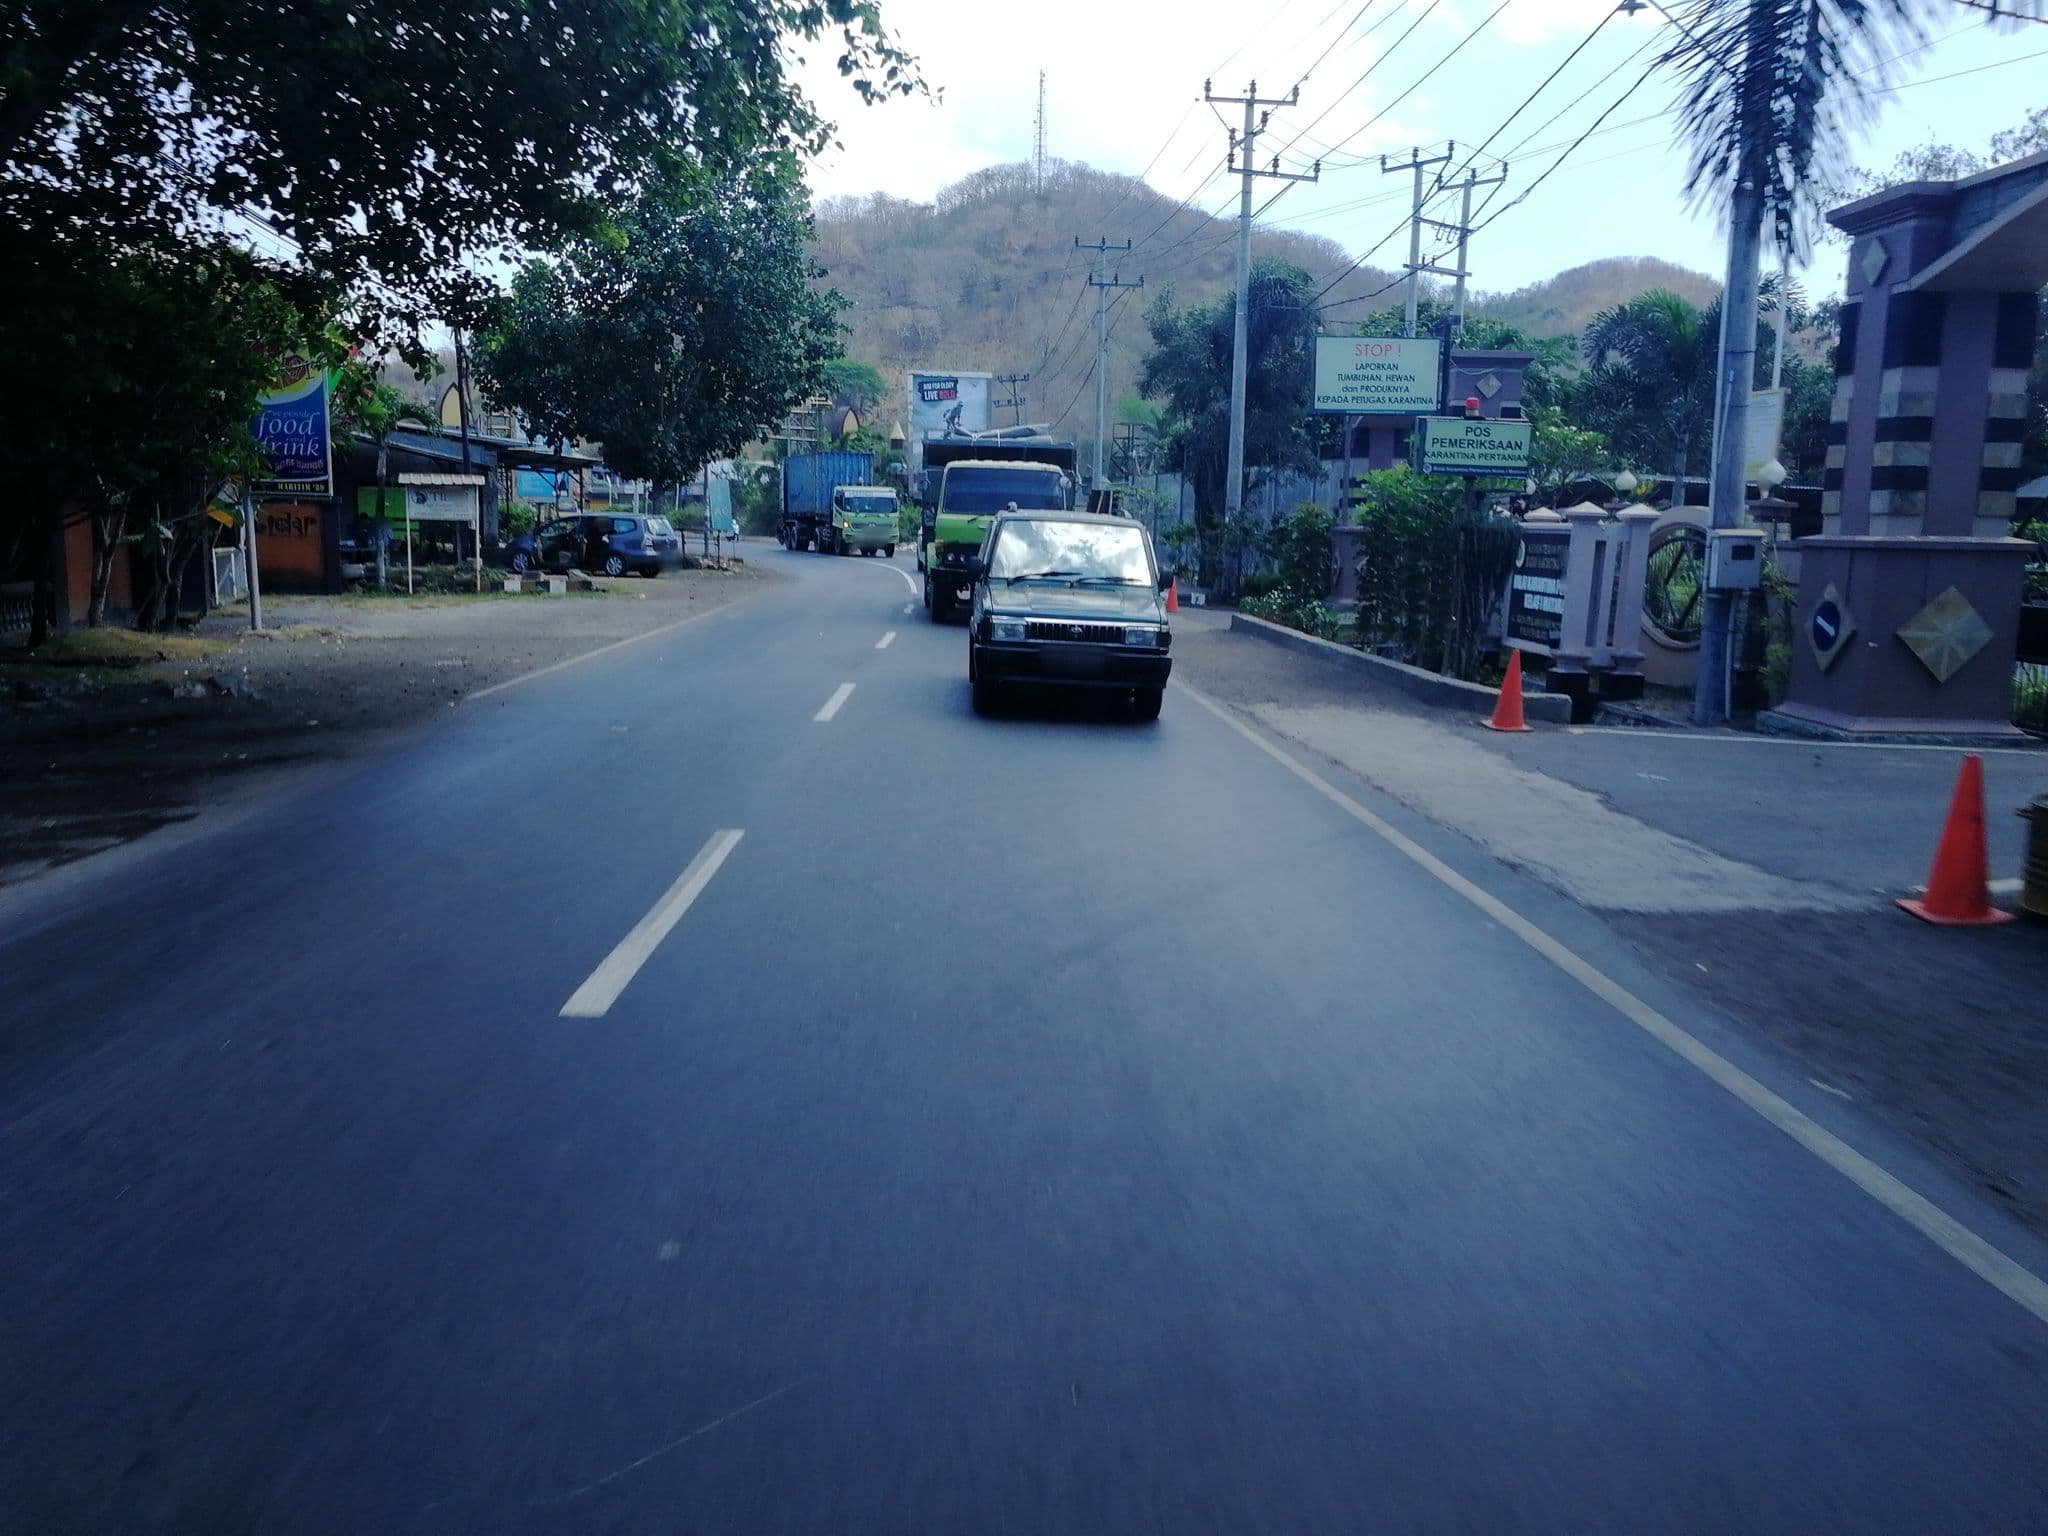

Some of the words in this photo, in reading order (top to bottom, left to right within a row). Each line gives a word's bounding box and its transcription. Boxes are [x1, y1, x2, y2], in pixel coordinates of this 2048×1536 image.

[1355, 344, 1392, 357] STOP
[1355, 363, 1399, 371] LAPORKAN
[1386, 374, 1416, 382] HEWAN
[1360, 385, 1410, 393] PRODUKNYA
[924, 390, 938, 400] LIVE
[938, 390, 955, 399] BOLD
[1317, 395, 1349, 404] KEPADA
[1351, 396, 1386, 404] PETUGAS
[1388, 396, 1434, 405] KARANTINA
[254, 411, 320, 441] food
[1465, 426, 1491, 438] POS
[1432, 437, 1523, 451] PEMERIKSAAN
[1424, 451, 1476, 460] KARANTINA
[1478, 453, 1529, 462] PERTANIAN
